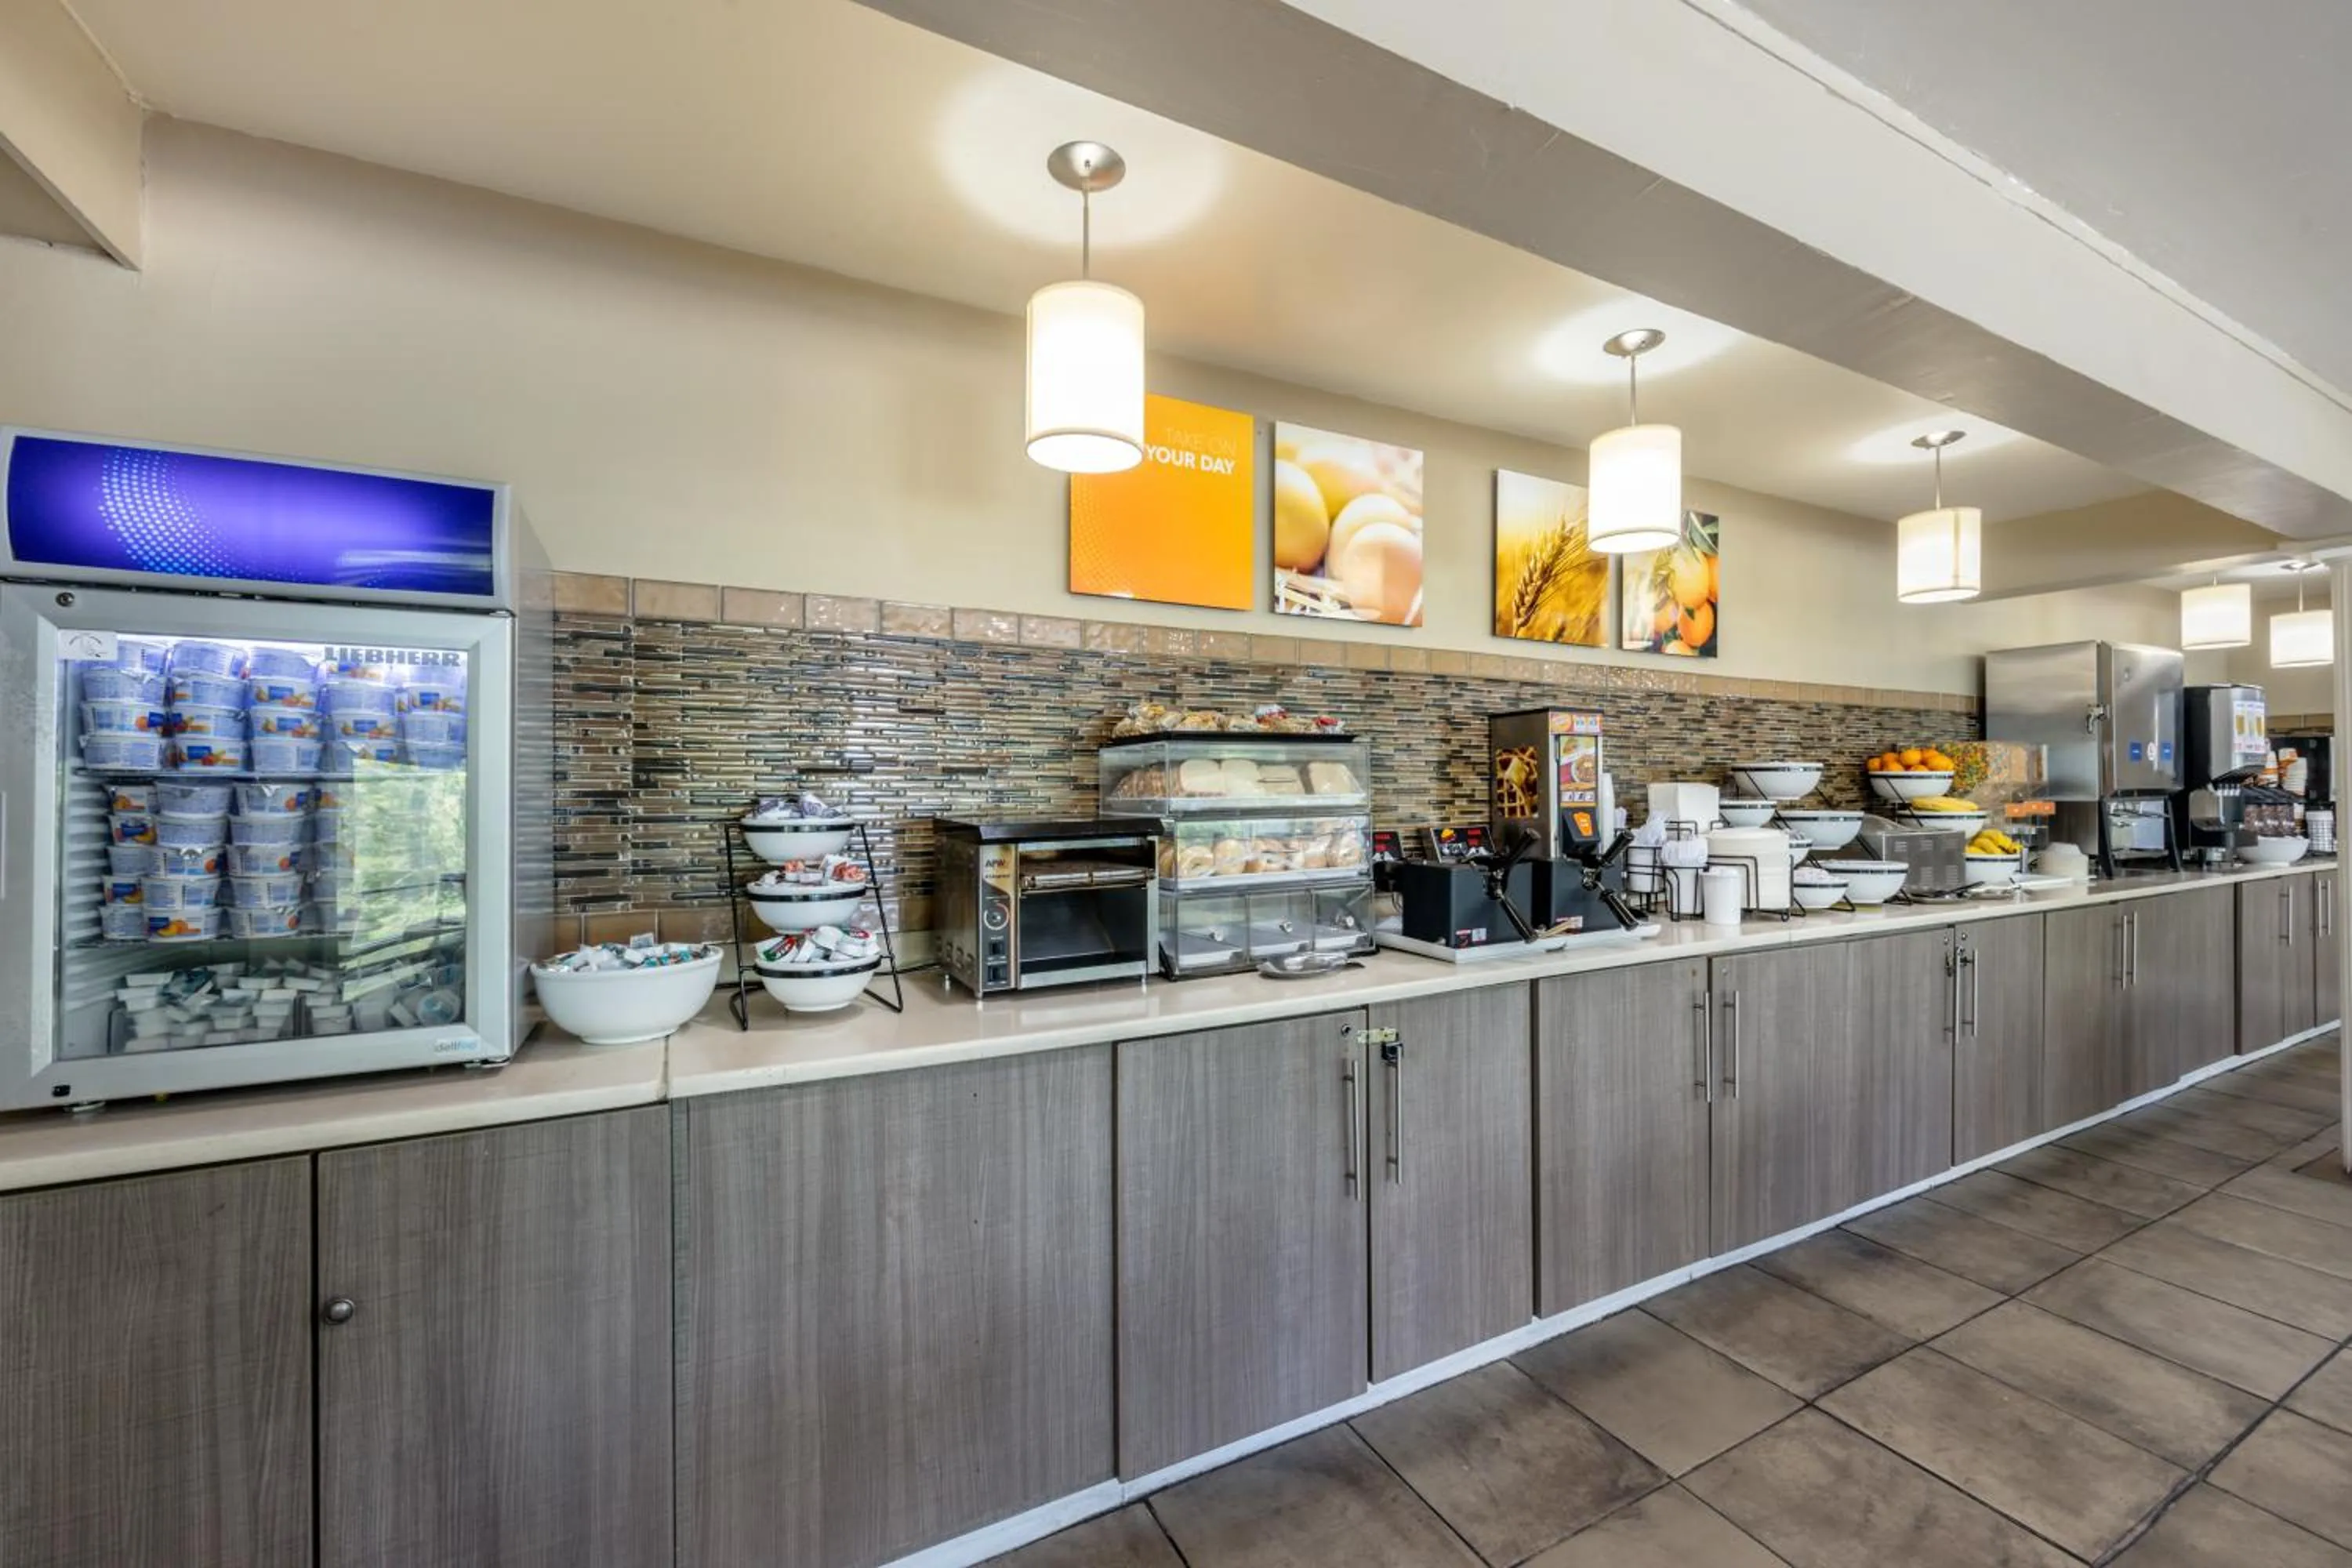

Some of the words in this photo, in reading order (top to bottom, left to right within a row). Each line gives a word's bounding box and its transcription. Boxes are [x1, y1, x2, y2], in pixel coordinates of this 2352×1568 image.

[1166, 426, 1205, 451] TAKE
[1145, 443, 1196, 470] YOUR
[1200, 454, 1236, 474] DAY
[325, 647, 461, 666] LIEBHERR
